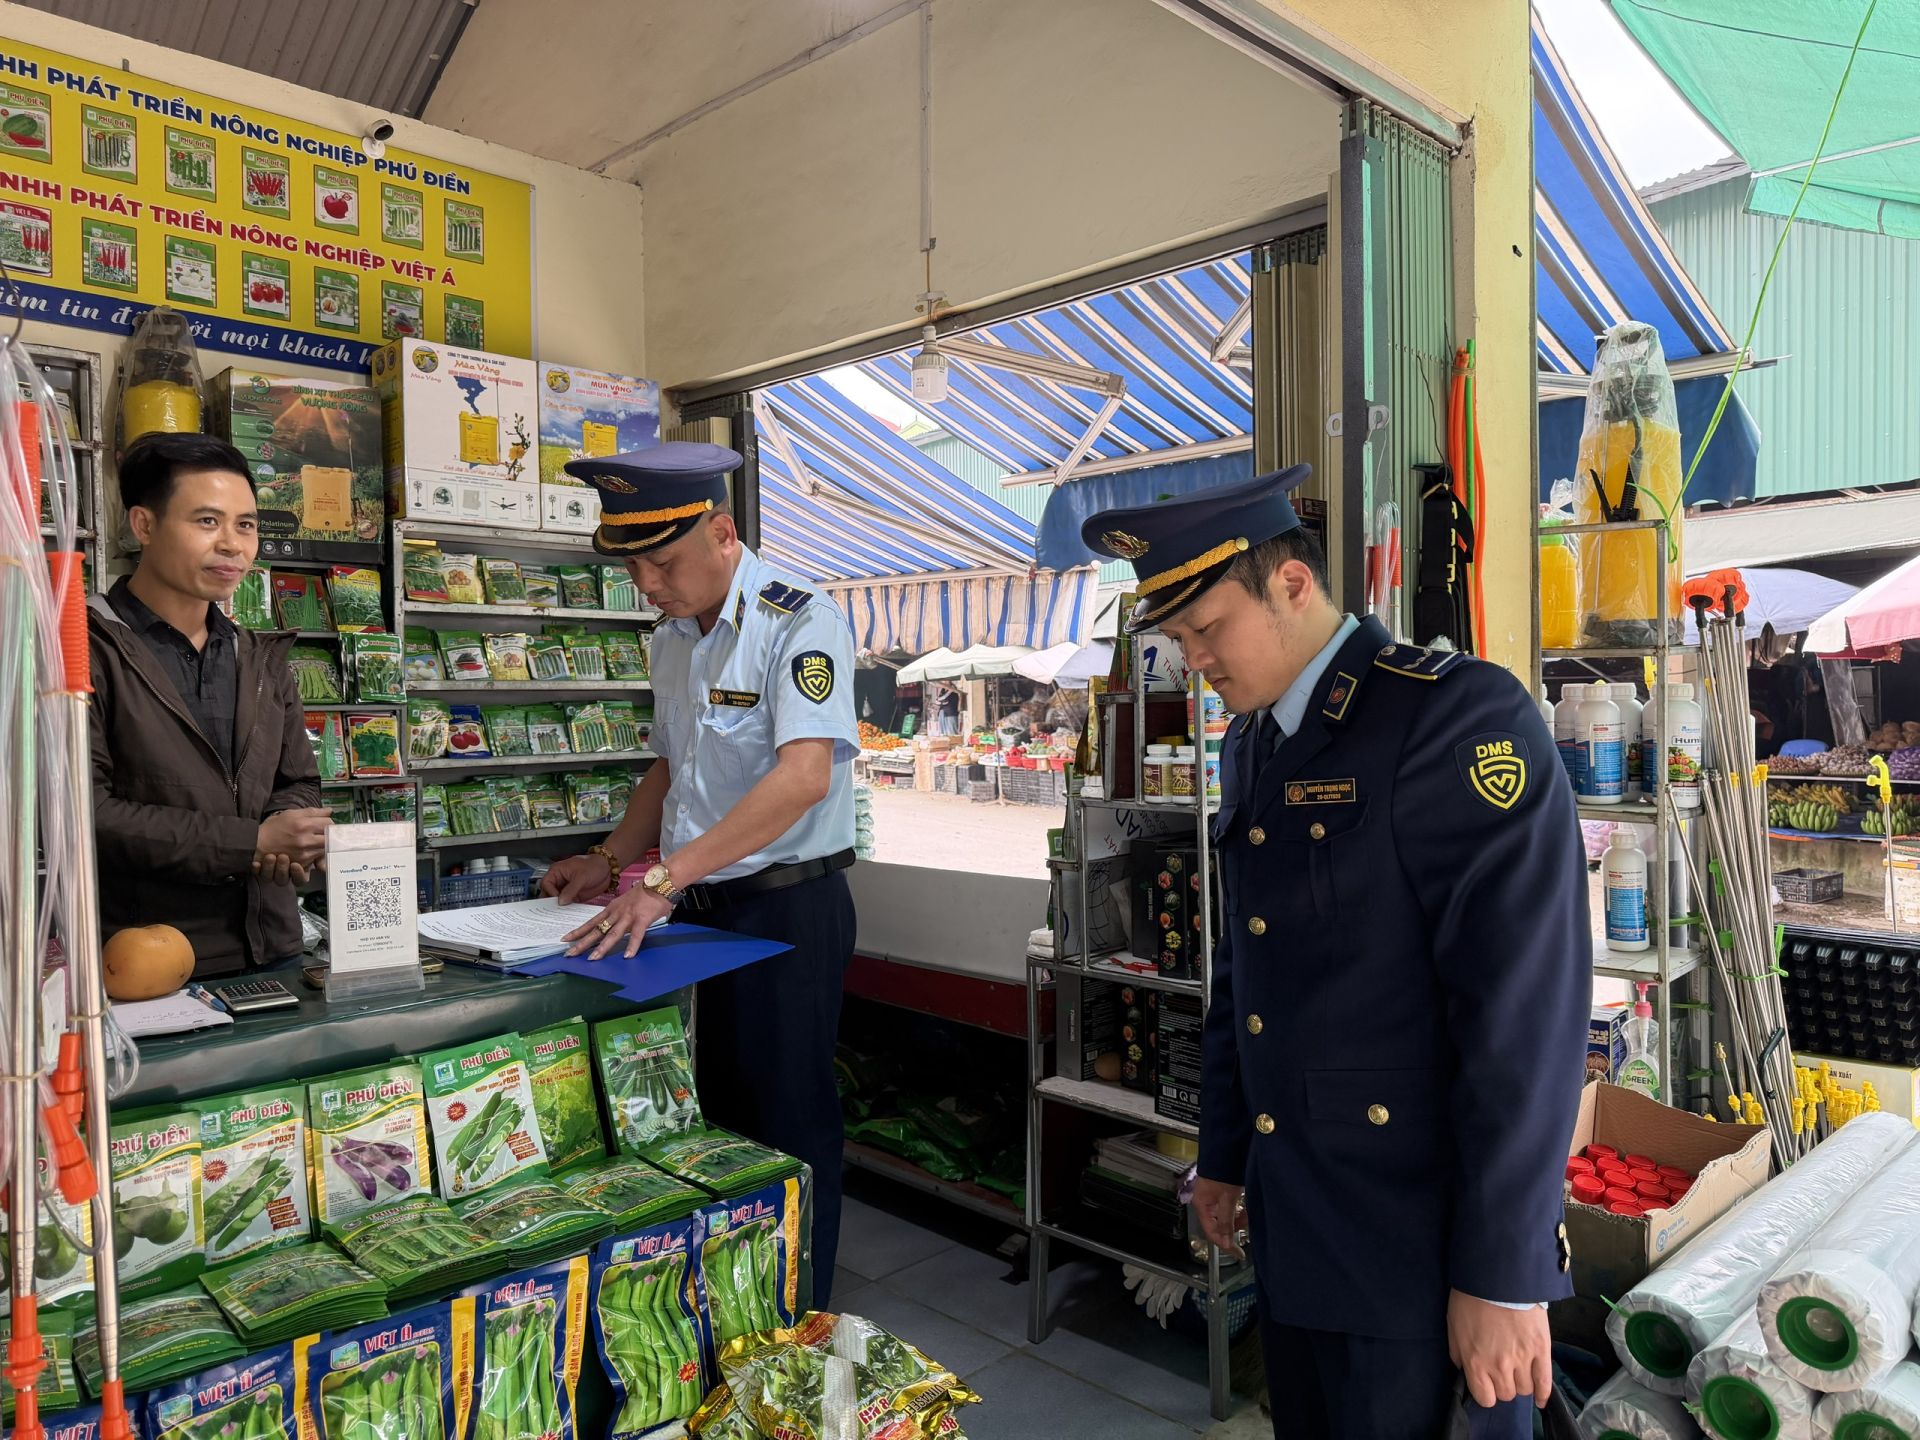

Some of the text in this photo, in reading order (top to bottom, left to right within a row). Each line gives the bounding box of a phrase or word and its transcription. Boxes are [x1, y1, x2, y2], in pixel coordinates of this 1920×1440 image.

[47, 67, 120, 101] PHÁT
[128, 89, 202, 124] TRIỂN
[211, 113, 279, 145] NÔNG
[286, 133, 368, 167] NGHIỆP
[374, 158, 417, 181] PHÚ
[422, 170, 471, 195] ĐIỀN
[70, 187, 142, 218] PHÁT
[149, 205, 223, 236] TRIỂN
[230, 224, 298, 252] NÔNG
[305, 240, 385, 271] NGHIỆP
[391, 258, 436, 283] VIỆT
[441, 267, 457, 287] Á
[60, 298, 102, 320] tin
[189, 320, 213, 339] ới
[221, 328, 269, 349] mọi
[278, 334, 351, 366] khách
[261, 518, 295, 529] Palatinum
[803, 657, 827, 667] DMS
[1475, 740, 1513, 759] DMS
[533, 1034, 581, 1057] PHÚ ĐIỀN
[460, 1046, 511, 1070] PHÚ ĐIỀN
[1626, 1074, 1654, 1085] GREEN
[1829, 1067, 1853, 1080] ẢN XUẤT
[345, 1076, 413, 1106] PHÚ ĐIỀN
[230, 1100, 292, 1125] PHÚ ĐIỀN
[148, 1123, 191, 1150] ĐIỀN
[731, 1204, 753, 1224] VIỆT
[638, 1235, 662, 1256] VIỆT
[525, 1279, 536, 1298] Á
[364, 1328, 398, 1354] VIỆT
[401, 1323, 413, 1342] Á
[198, 1380, 235, 1407] VIỆT
[240, 1370, 252, 1391] Á
[775, 1426, 791, 1440] HN
